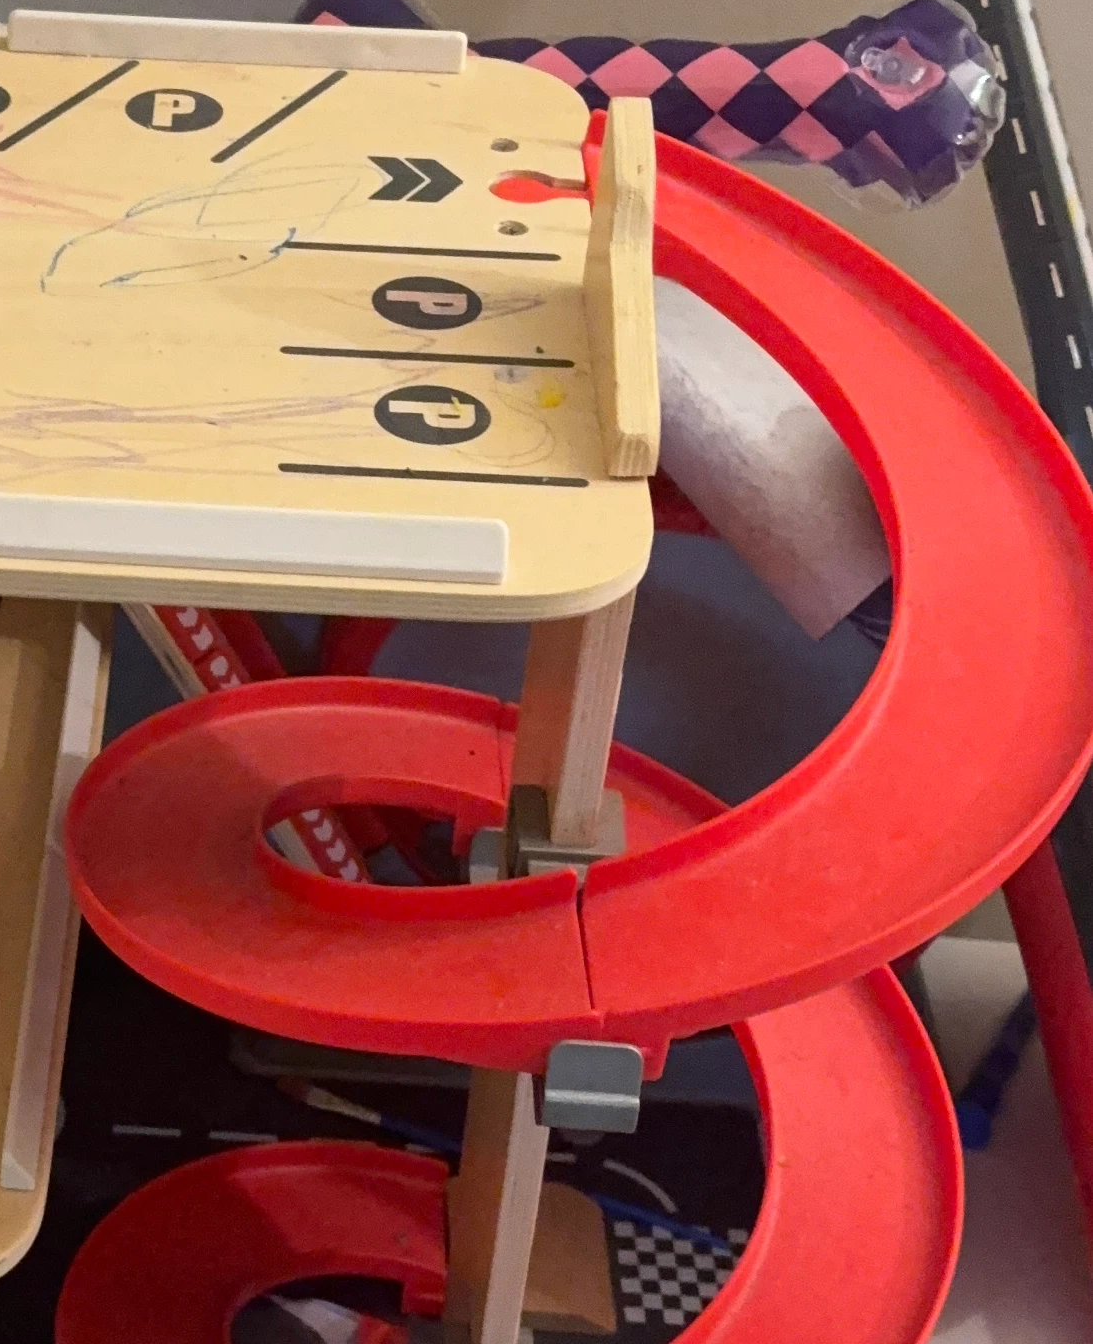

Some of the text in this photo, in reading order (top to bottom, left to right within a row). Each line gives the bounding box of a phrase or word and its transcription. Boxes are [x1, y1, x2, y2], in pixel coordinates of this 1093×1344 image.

[152, 93, 196, 126] P
[386, 290, 468, 316] P
[389, 400, 476, 429] P
